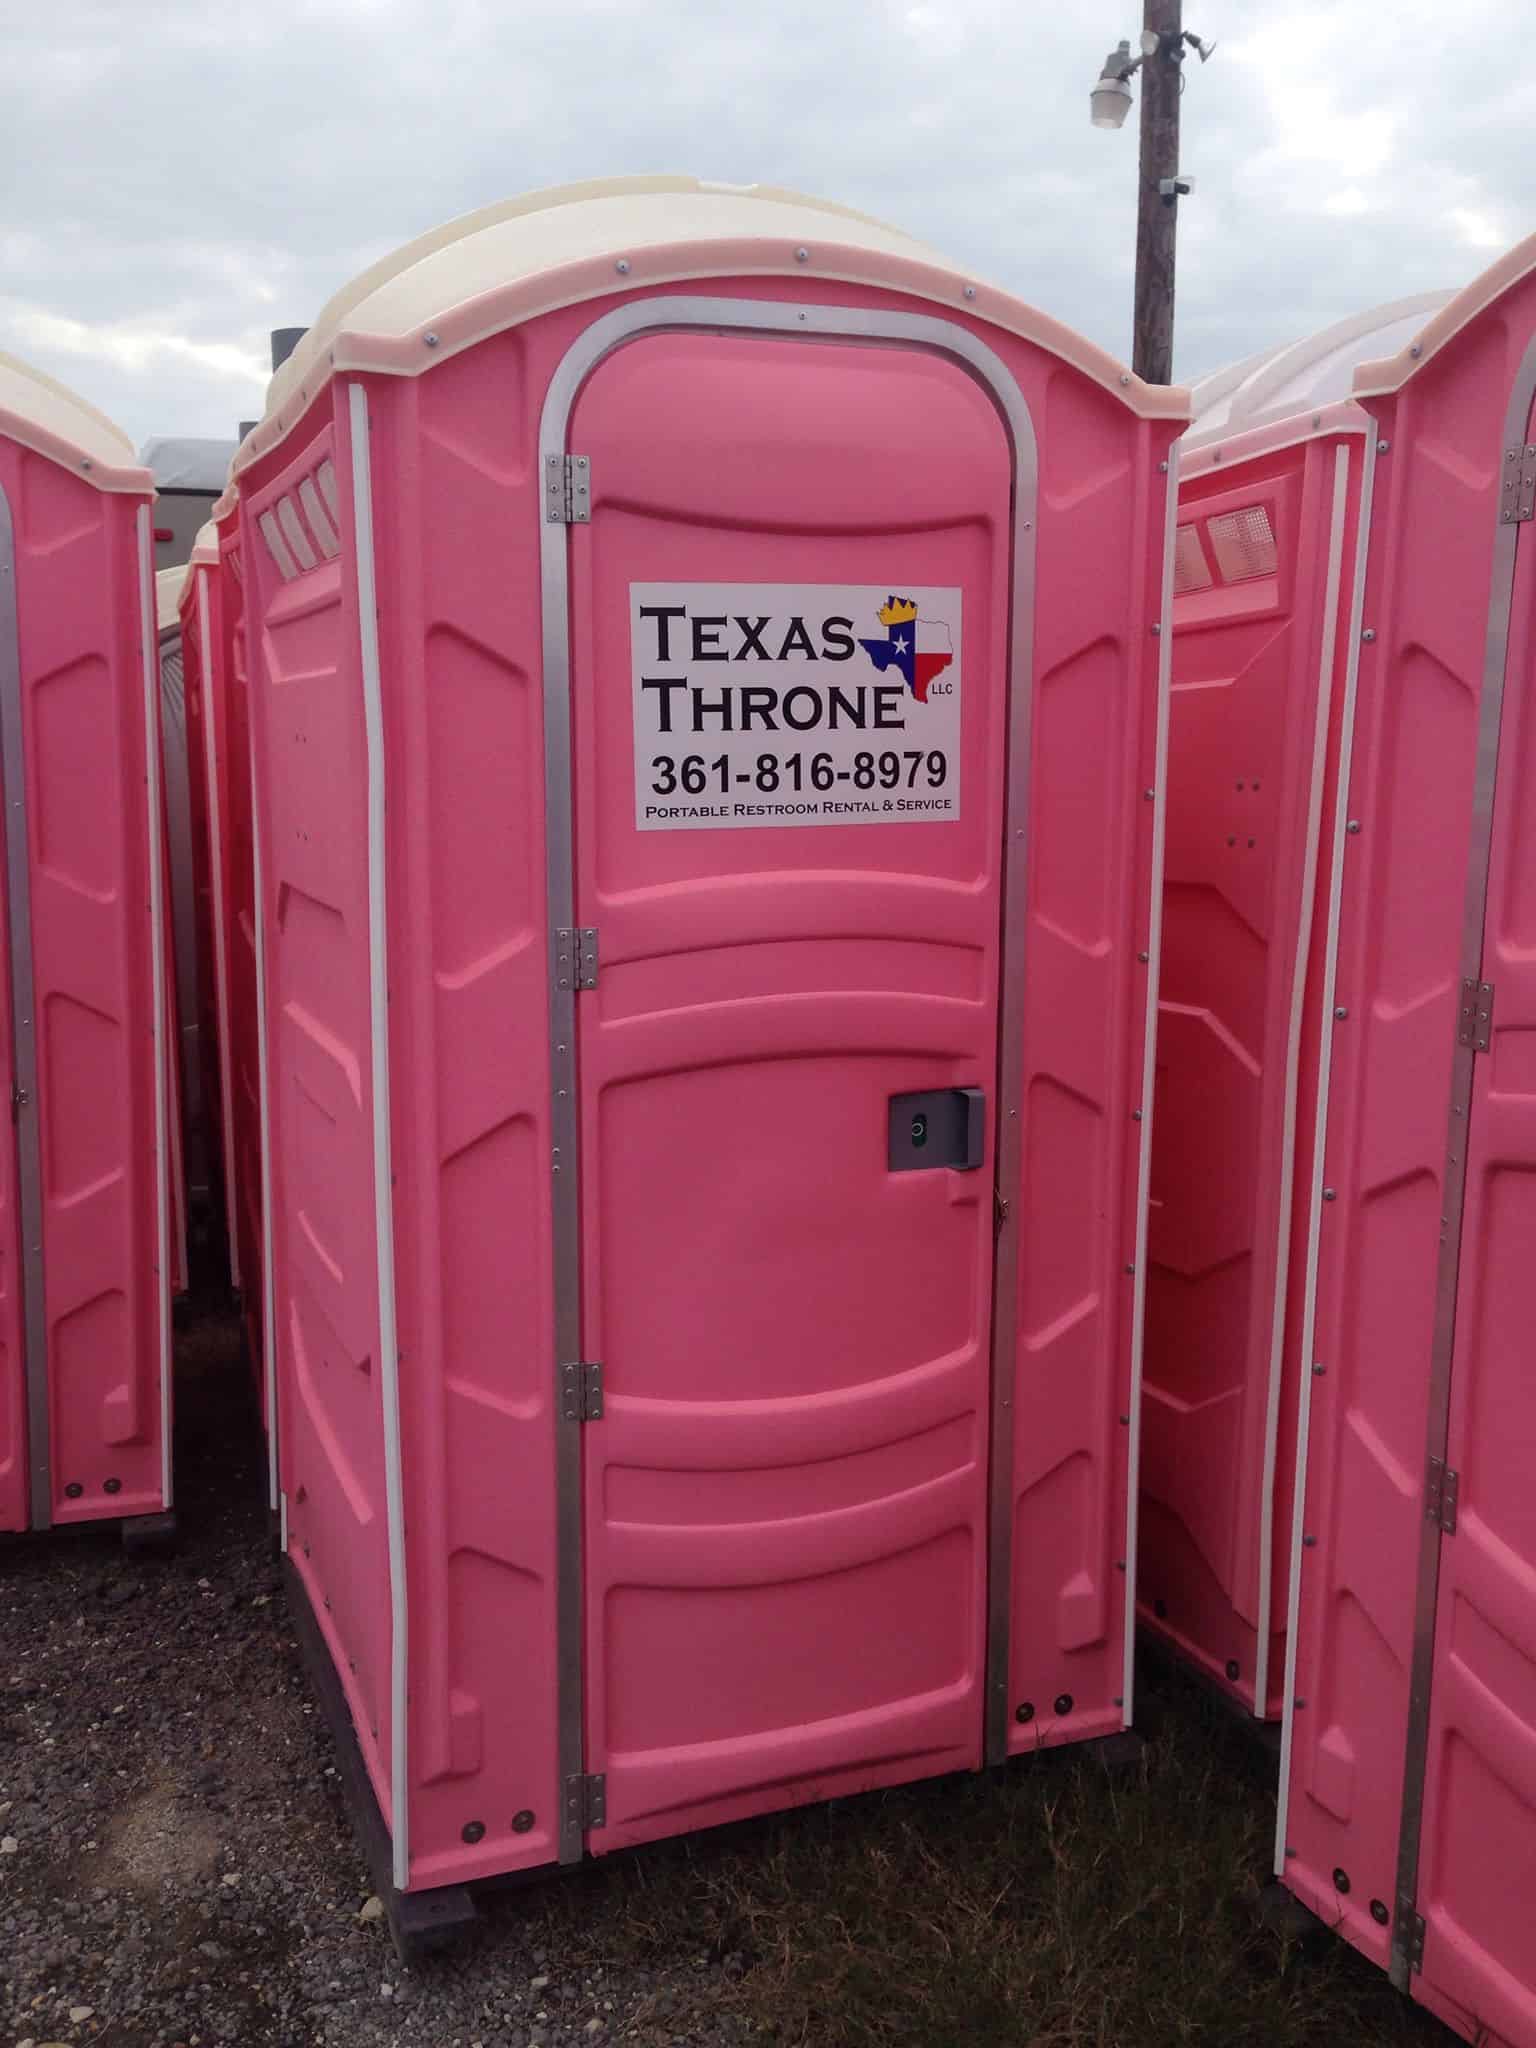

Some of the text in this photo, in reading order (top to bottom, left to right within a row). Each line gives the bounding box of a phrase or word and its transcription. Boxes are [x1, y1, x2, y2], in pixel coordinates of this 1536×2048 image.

[640, 605, 855, 662] TEXAS
[642, 677, 905, 732] THRONE
[931, 683, 953, 695] LLC
[651, 750, 947, 795] 361-816-8979
[646, 798, 952, 818] PORTABLE RESTROOM RENTAL & SERVICE
